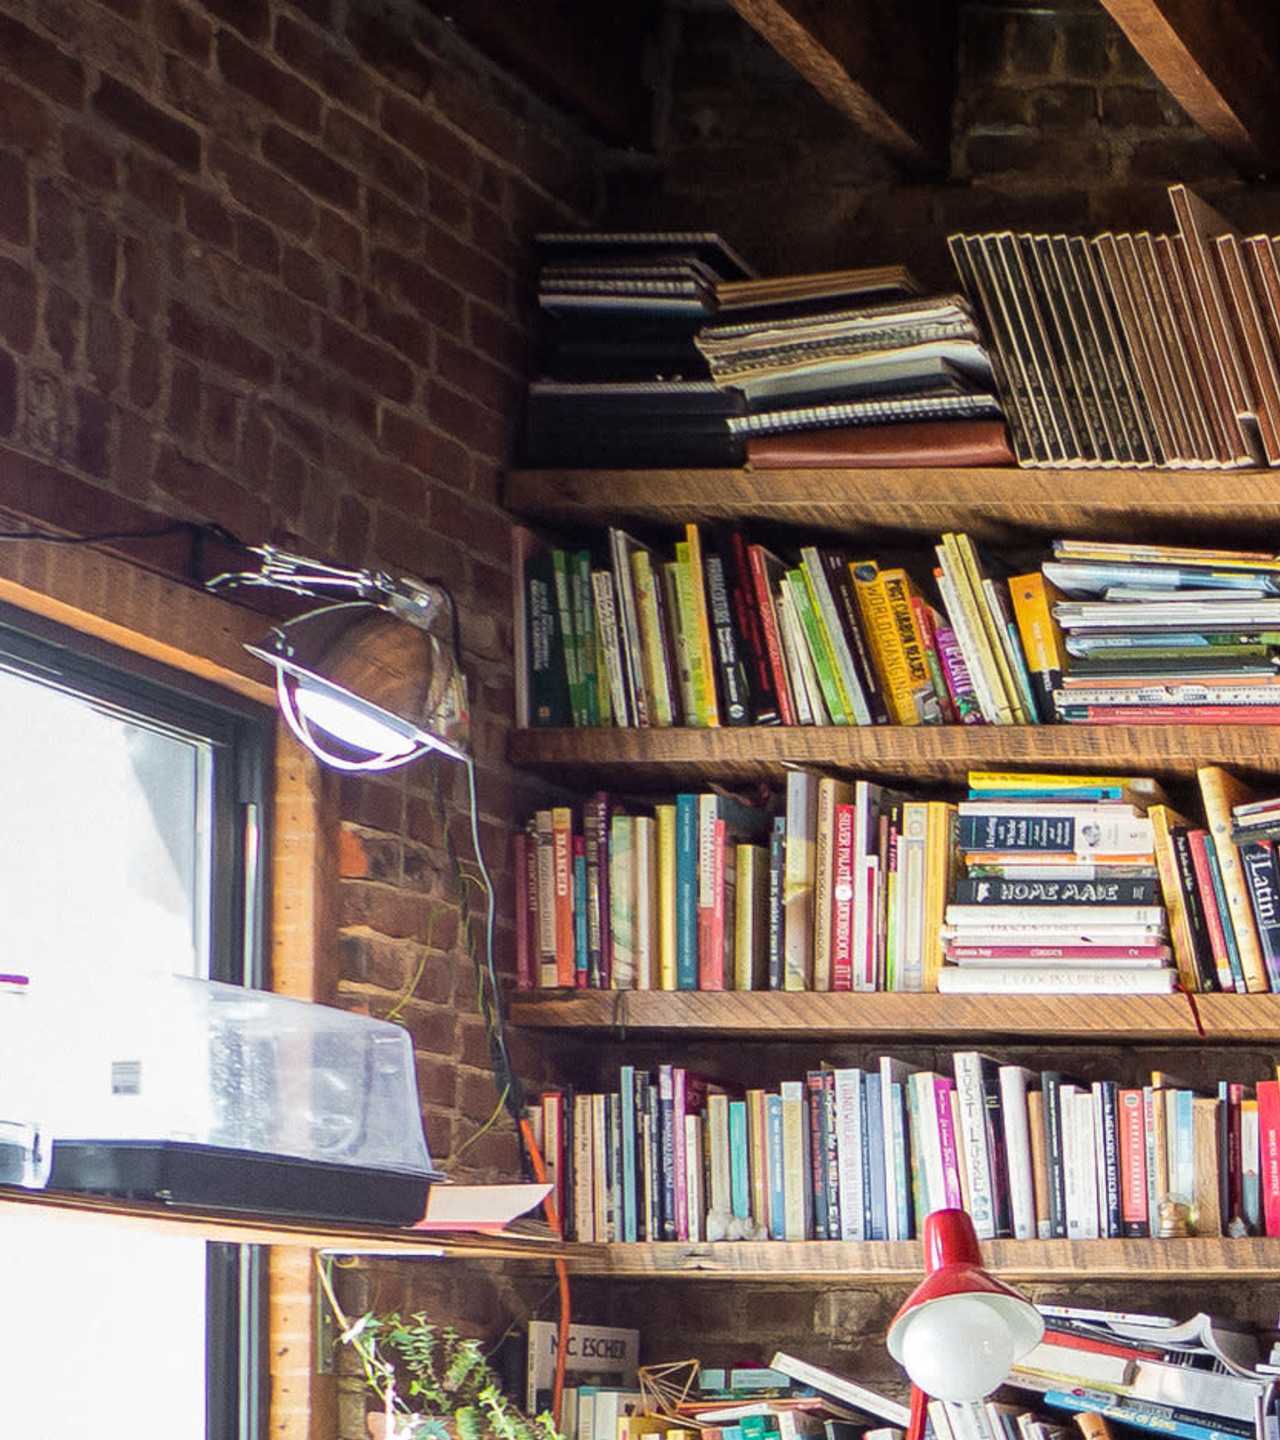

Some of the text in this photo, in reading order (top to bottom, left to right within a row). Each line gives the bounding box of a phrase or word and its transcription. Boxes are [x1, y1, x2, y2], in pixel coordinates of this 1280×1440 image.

[1001, 881, 1119, 901] HOME MADE
[1251, 862, 1277, 920] Latin
